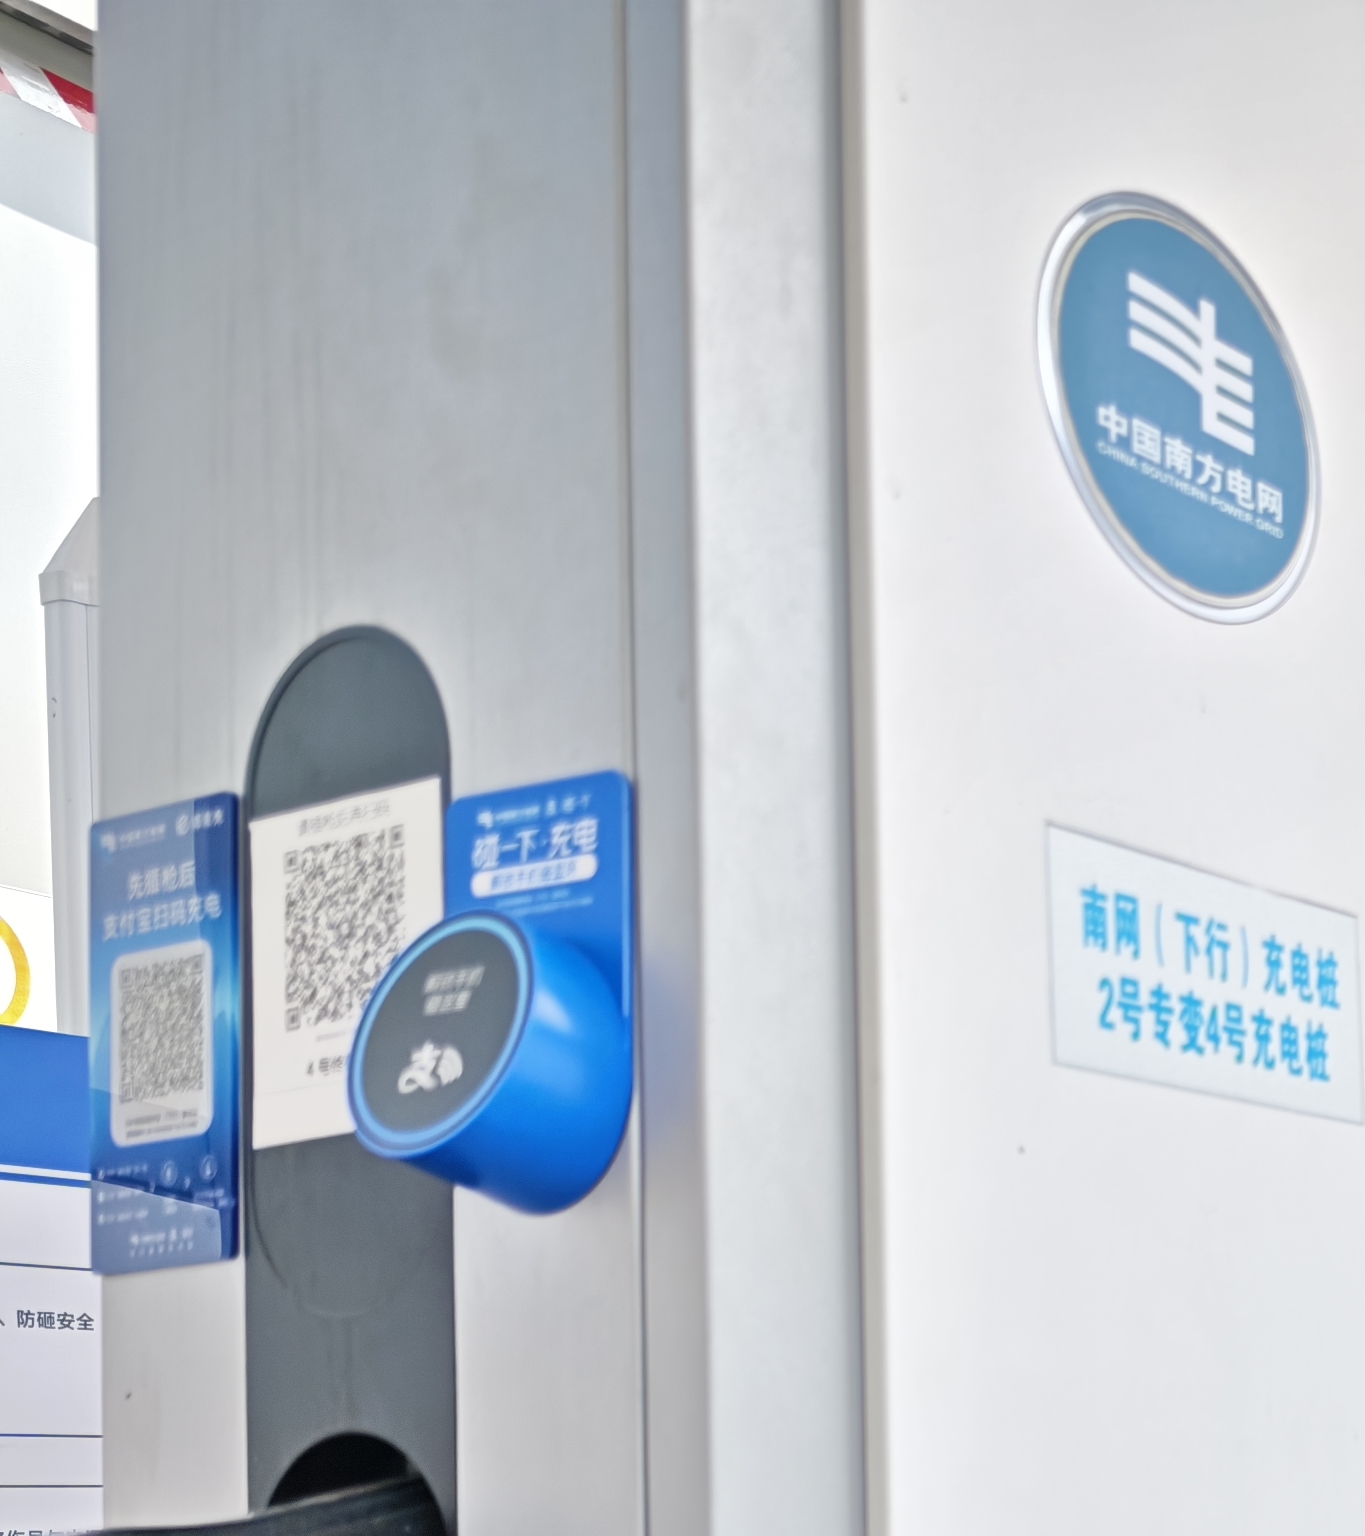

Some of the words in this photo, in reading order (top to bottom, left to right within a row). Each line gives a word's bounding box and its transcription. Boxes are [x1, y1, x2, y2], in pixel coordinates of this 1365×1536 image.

[1096, 405, 1284, 524] 中国南方电网
[1096, 439, 1137, 469] CHINA
[1140, 461, 1209, 503] SOUTHERN
[1210, 495, 1254, 526] POWER
[1255, 517, 1285, 540] GRID
[1080, 883, 1341, 1010] 南网（下行）充电桩
[1098, 976, 1331, 1082] 2号专变4号充电桩
